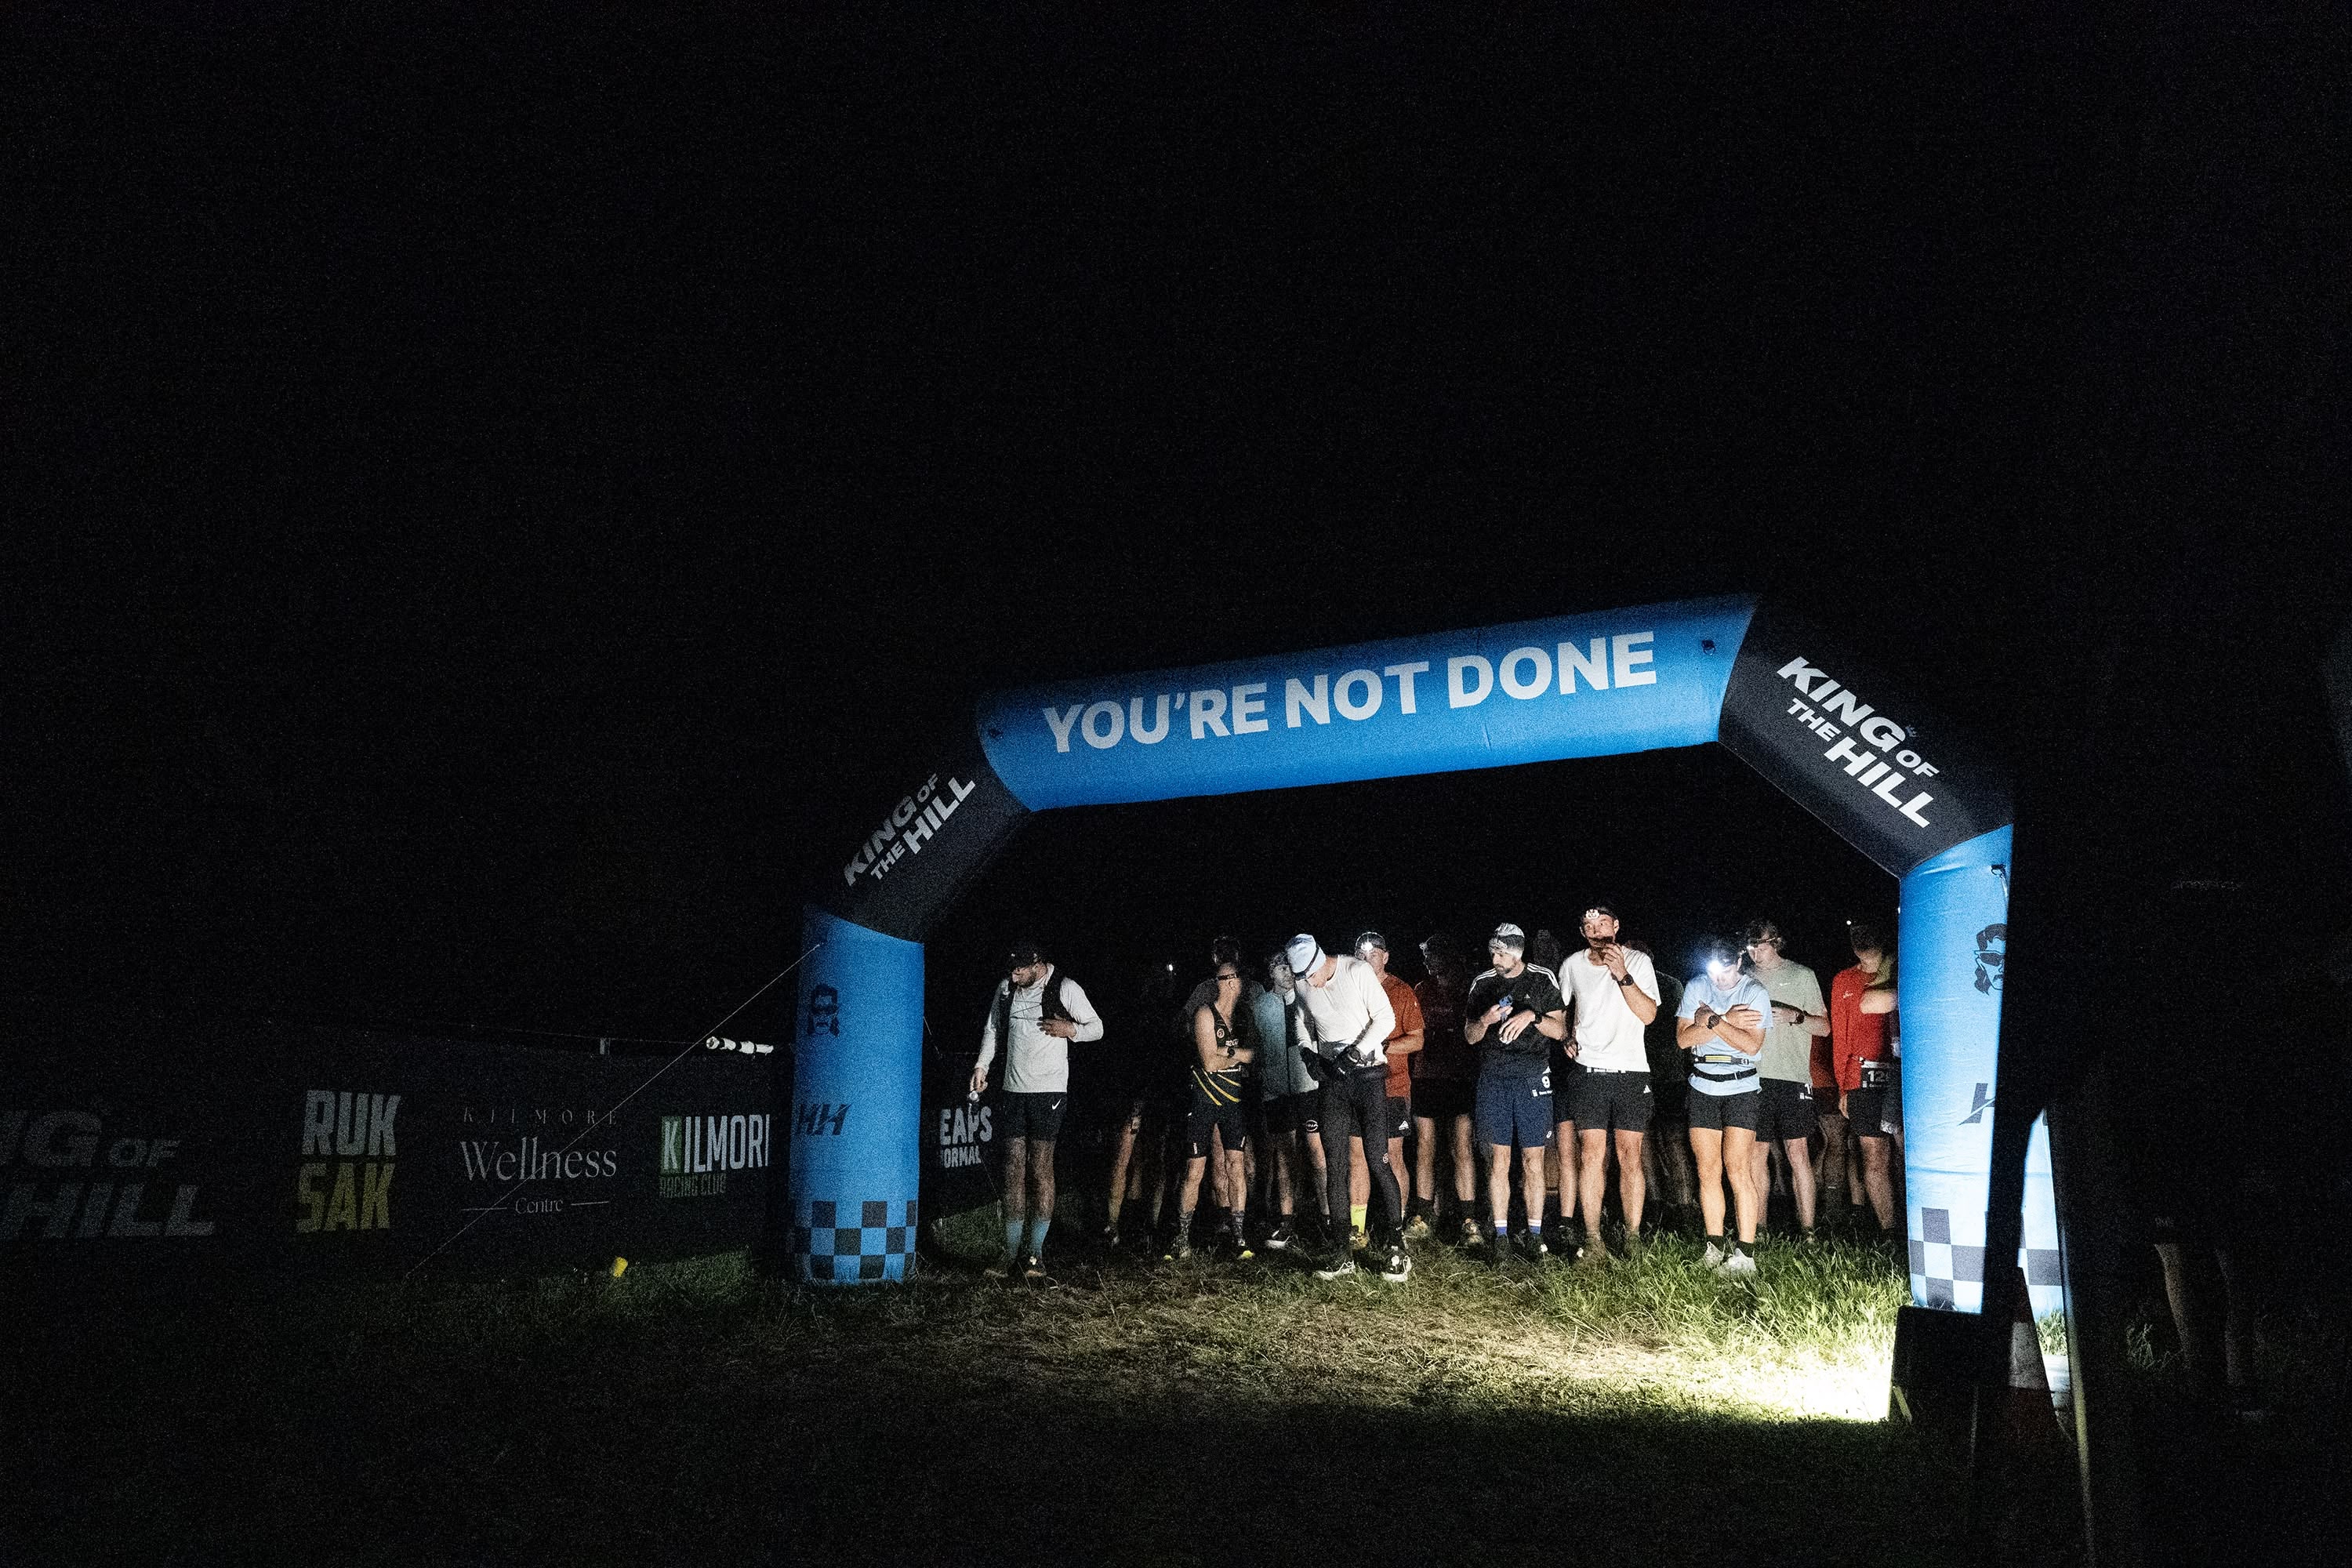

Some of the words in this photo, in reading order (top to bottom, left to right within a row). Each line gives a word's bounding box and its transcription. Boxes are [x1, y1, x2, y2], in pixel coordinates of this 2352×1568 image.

[1042, 683, 1269, 753] YOU'RE
[1285, 662, 1429, 728] NOT
[1447, 631, 1657, 708] DONE
[1777, 656, 1906, 753] KING
[1896, 750, 1940, 777] OF
[1787, 698, 1841, 742] THE
[1824, 736, 1933, 828] HILL
[843, 795, 917, 887] KING
[916, 773, 938, 804] OF
[870, 840, 906, 880] THE
[902, 777, 976, 855] HILL
[108, 1138, 181, 1167] OF
[301, 1090, 401, 1156] RUK
[941, 1145, 982, 1168] ORMAL
[459, 1136, 618, 1181] Wellness
[0, 1182, 215, 1240] HILL
[296, 1162, 395, 1232] SAK
[515, 1197, 564, 1214] Centre
